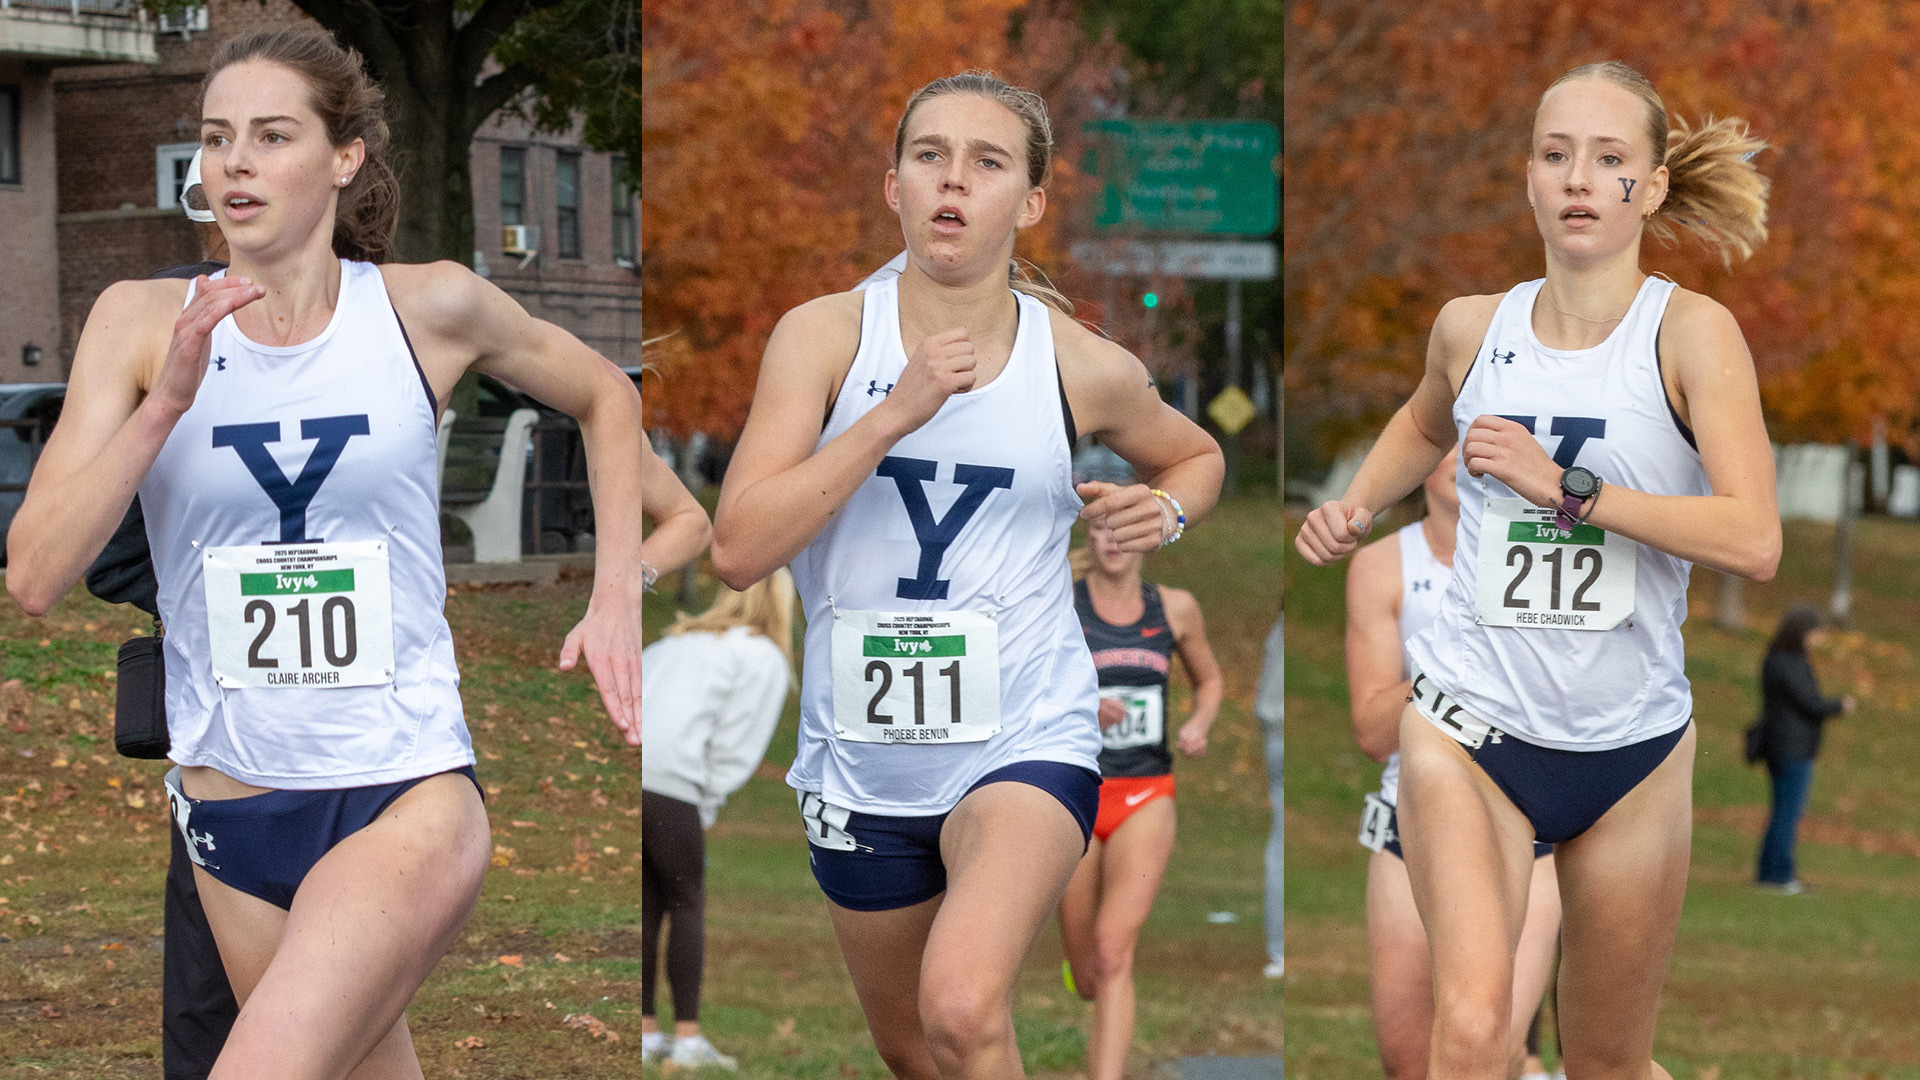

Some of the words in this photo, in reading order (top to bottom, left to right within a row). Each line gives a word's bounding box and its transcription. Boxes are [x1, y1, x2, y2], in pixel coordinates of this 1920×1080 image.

[1618, 177, 1637, 203] Y
[212, 414, 371, 546] Y
[876, 455, 1016, 601] Y
[1536, 524, 1559, 541] Ivy
[273, 556, 296, 564] COUNTRY
[297, 555, 338, 563] CHAMPIONSHIPS
[274, 549, 288, 557] 2025
[288, 548, 319, 556] HEPTAGONAL
[275, 574, 303, 592] Ivy
[1503, 544, 1603, 611] 212
[1516, 612, 1538, 624] HEBE
[1540, 613, 1586, 626] CHADWICK
[244, 595, 358, 668] 210
[893, 638, 919, 655] Ivy
[267, 672, 300, 685] CLAIRE
[302, 671, 340, 684] ARCHER
[864, 659, 962, 725] 211
[883, 728, 917, 740] PHOEBE
[919, 728, 949, 740] BENUN
